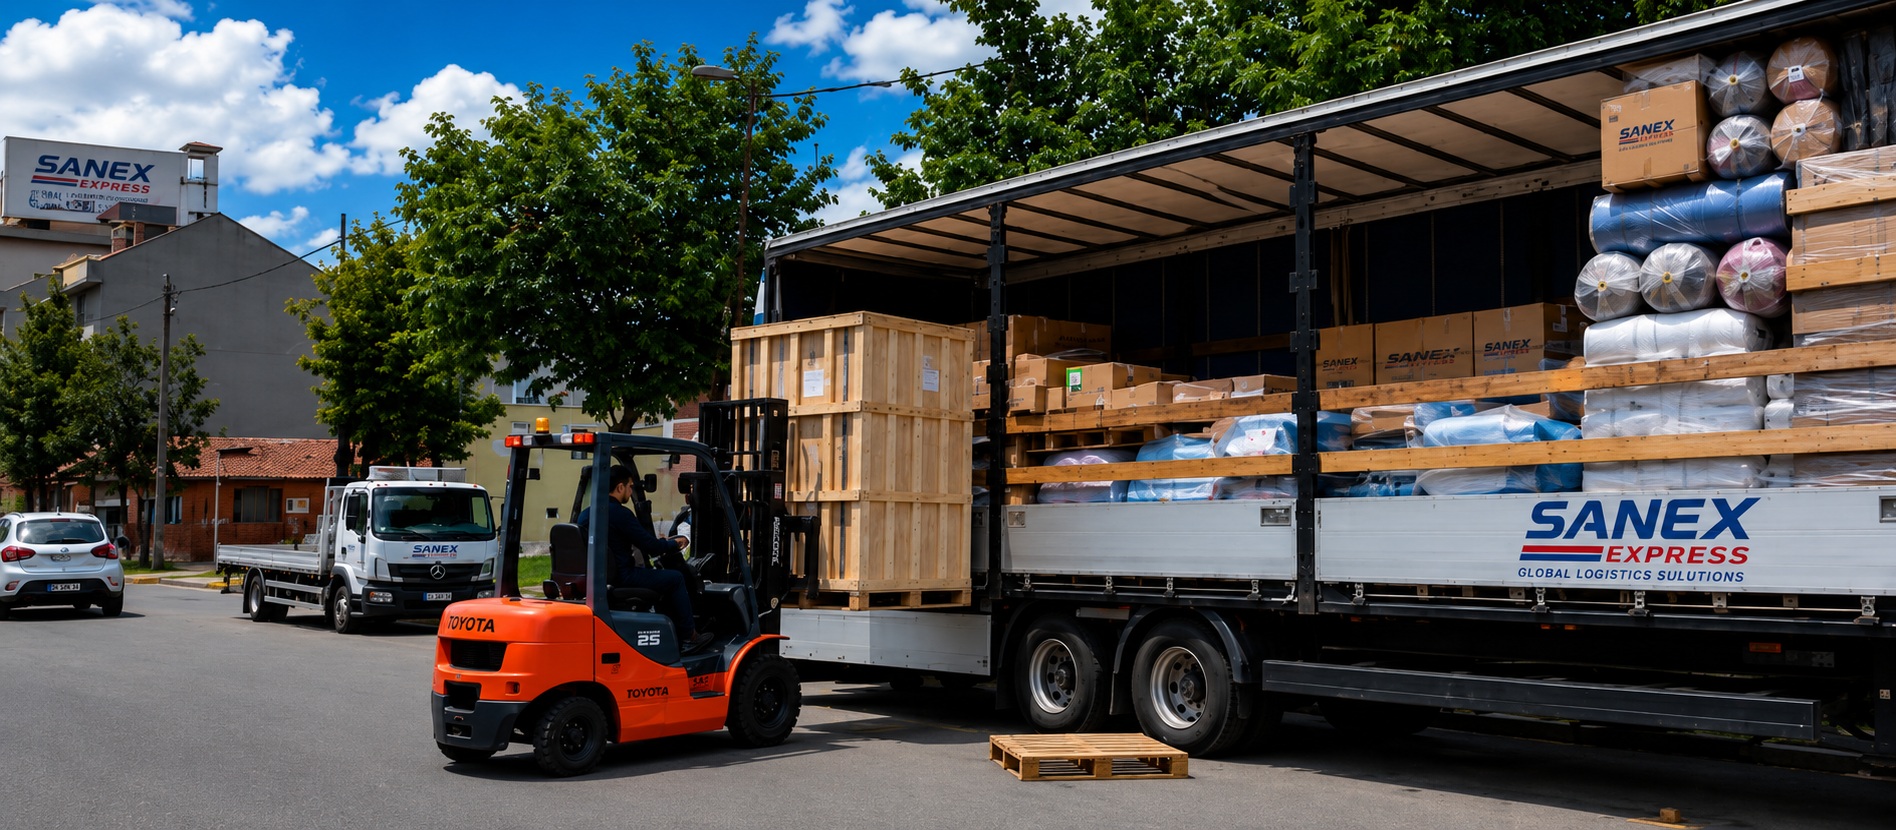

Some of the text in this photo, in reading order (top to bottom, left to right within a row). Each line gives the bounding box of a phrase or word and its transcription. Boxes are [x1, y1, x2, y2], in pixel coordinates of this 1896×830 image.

[1619, 119, 1675, 140] SANEX
[35, 154, 155, 183] SANEX
[79, 180, 151, 194] EXPRESS
[1484, 338, 1531, 352] SANEX
[1322, 357, 1358, 368] SANEX
[1525, 497, 1761, 540] SANEX
[412, 545, 459, 554] SANEX
[1605, 545, 1750, 565] EXPRESS
[1518, 567, 1745, 583] GLOBAL LOGISTICS SULUTIONS
[448, 615, 495, 633] TOYOTA
[637, 634, 660, 646] 25
[627, 686, 669, 699] TOYOTA
